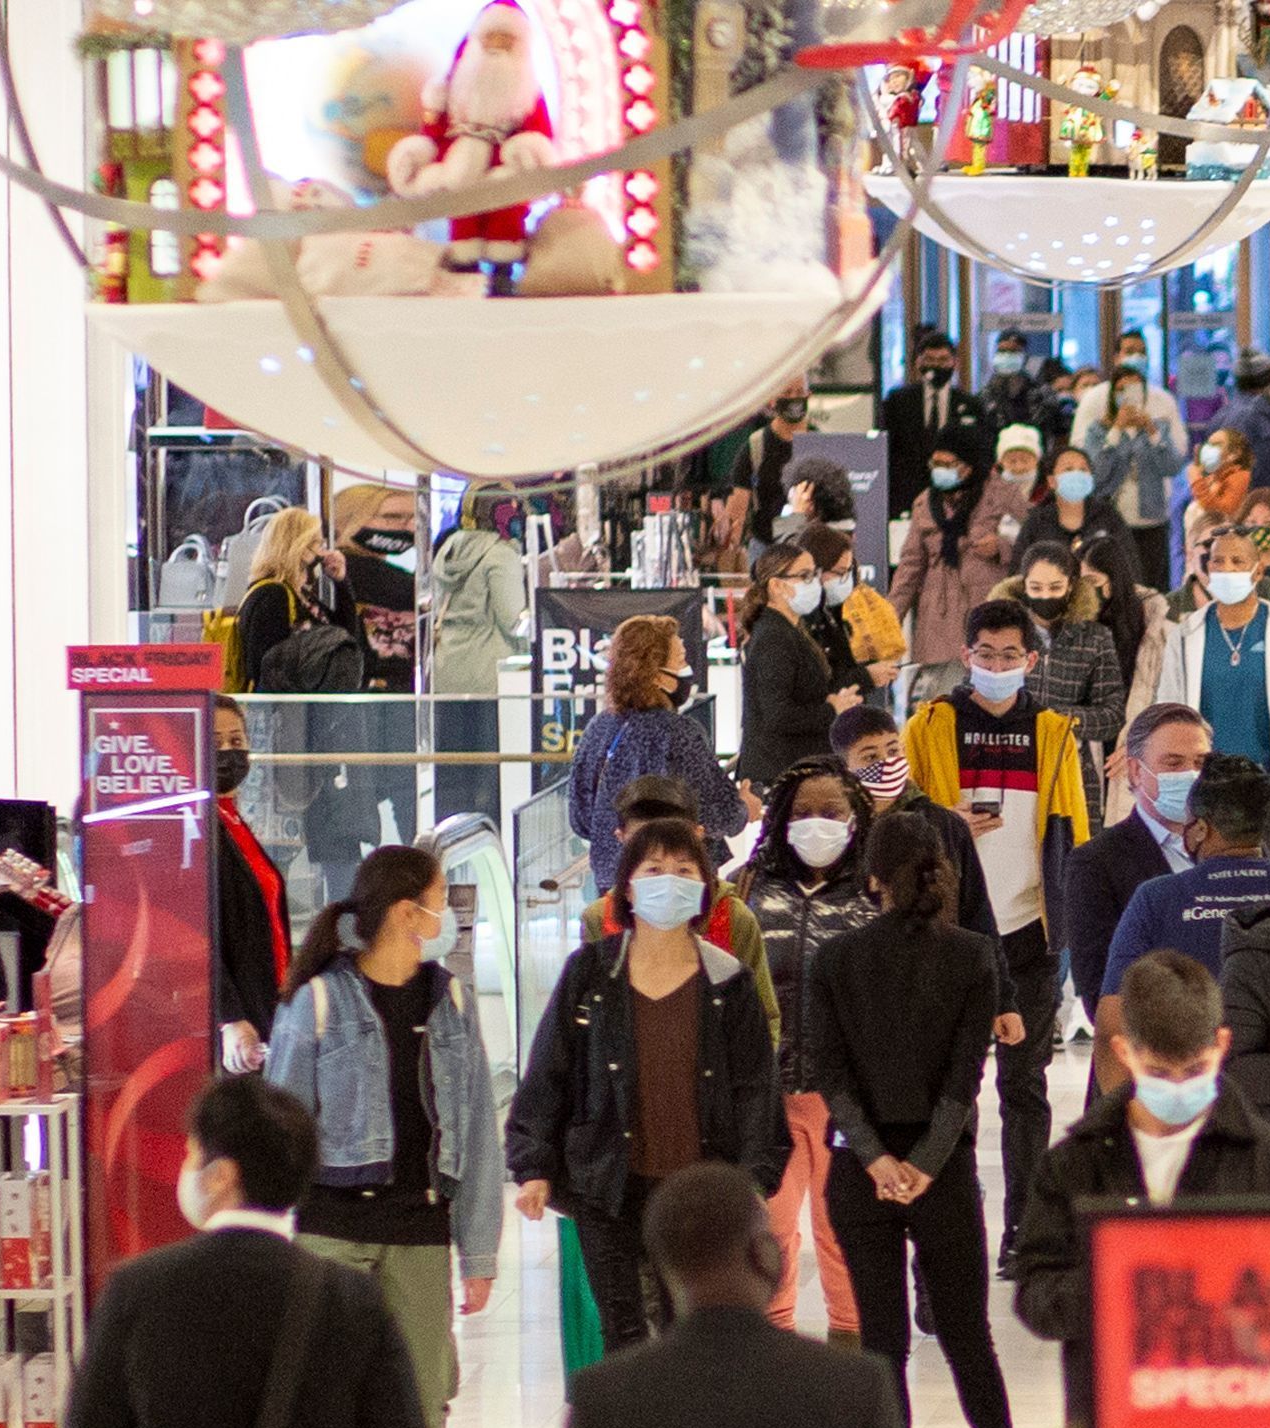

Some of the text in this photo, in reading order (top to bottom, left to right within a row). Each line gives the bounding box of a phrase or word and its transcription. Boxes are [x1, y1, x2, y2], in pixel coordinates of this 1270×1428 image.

[72, 652, 136, 666] BLACK
[71, 667, 153, 683] SPECIAL
[94, 735, 155, 753] GIVE.
[964, 732, 1030, 746] HOLLISTER
[110, 755, 178, 773] LOVE.
